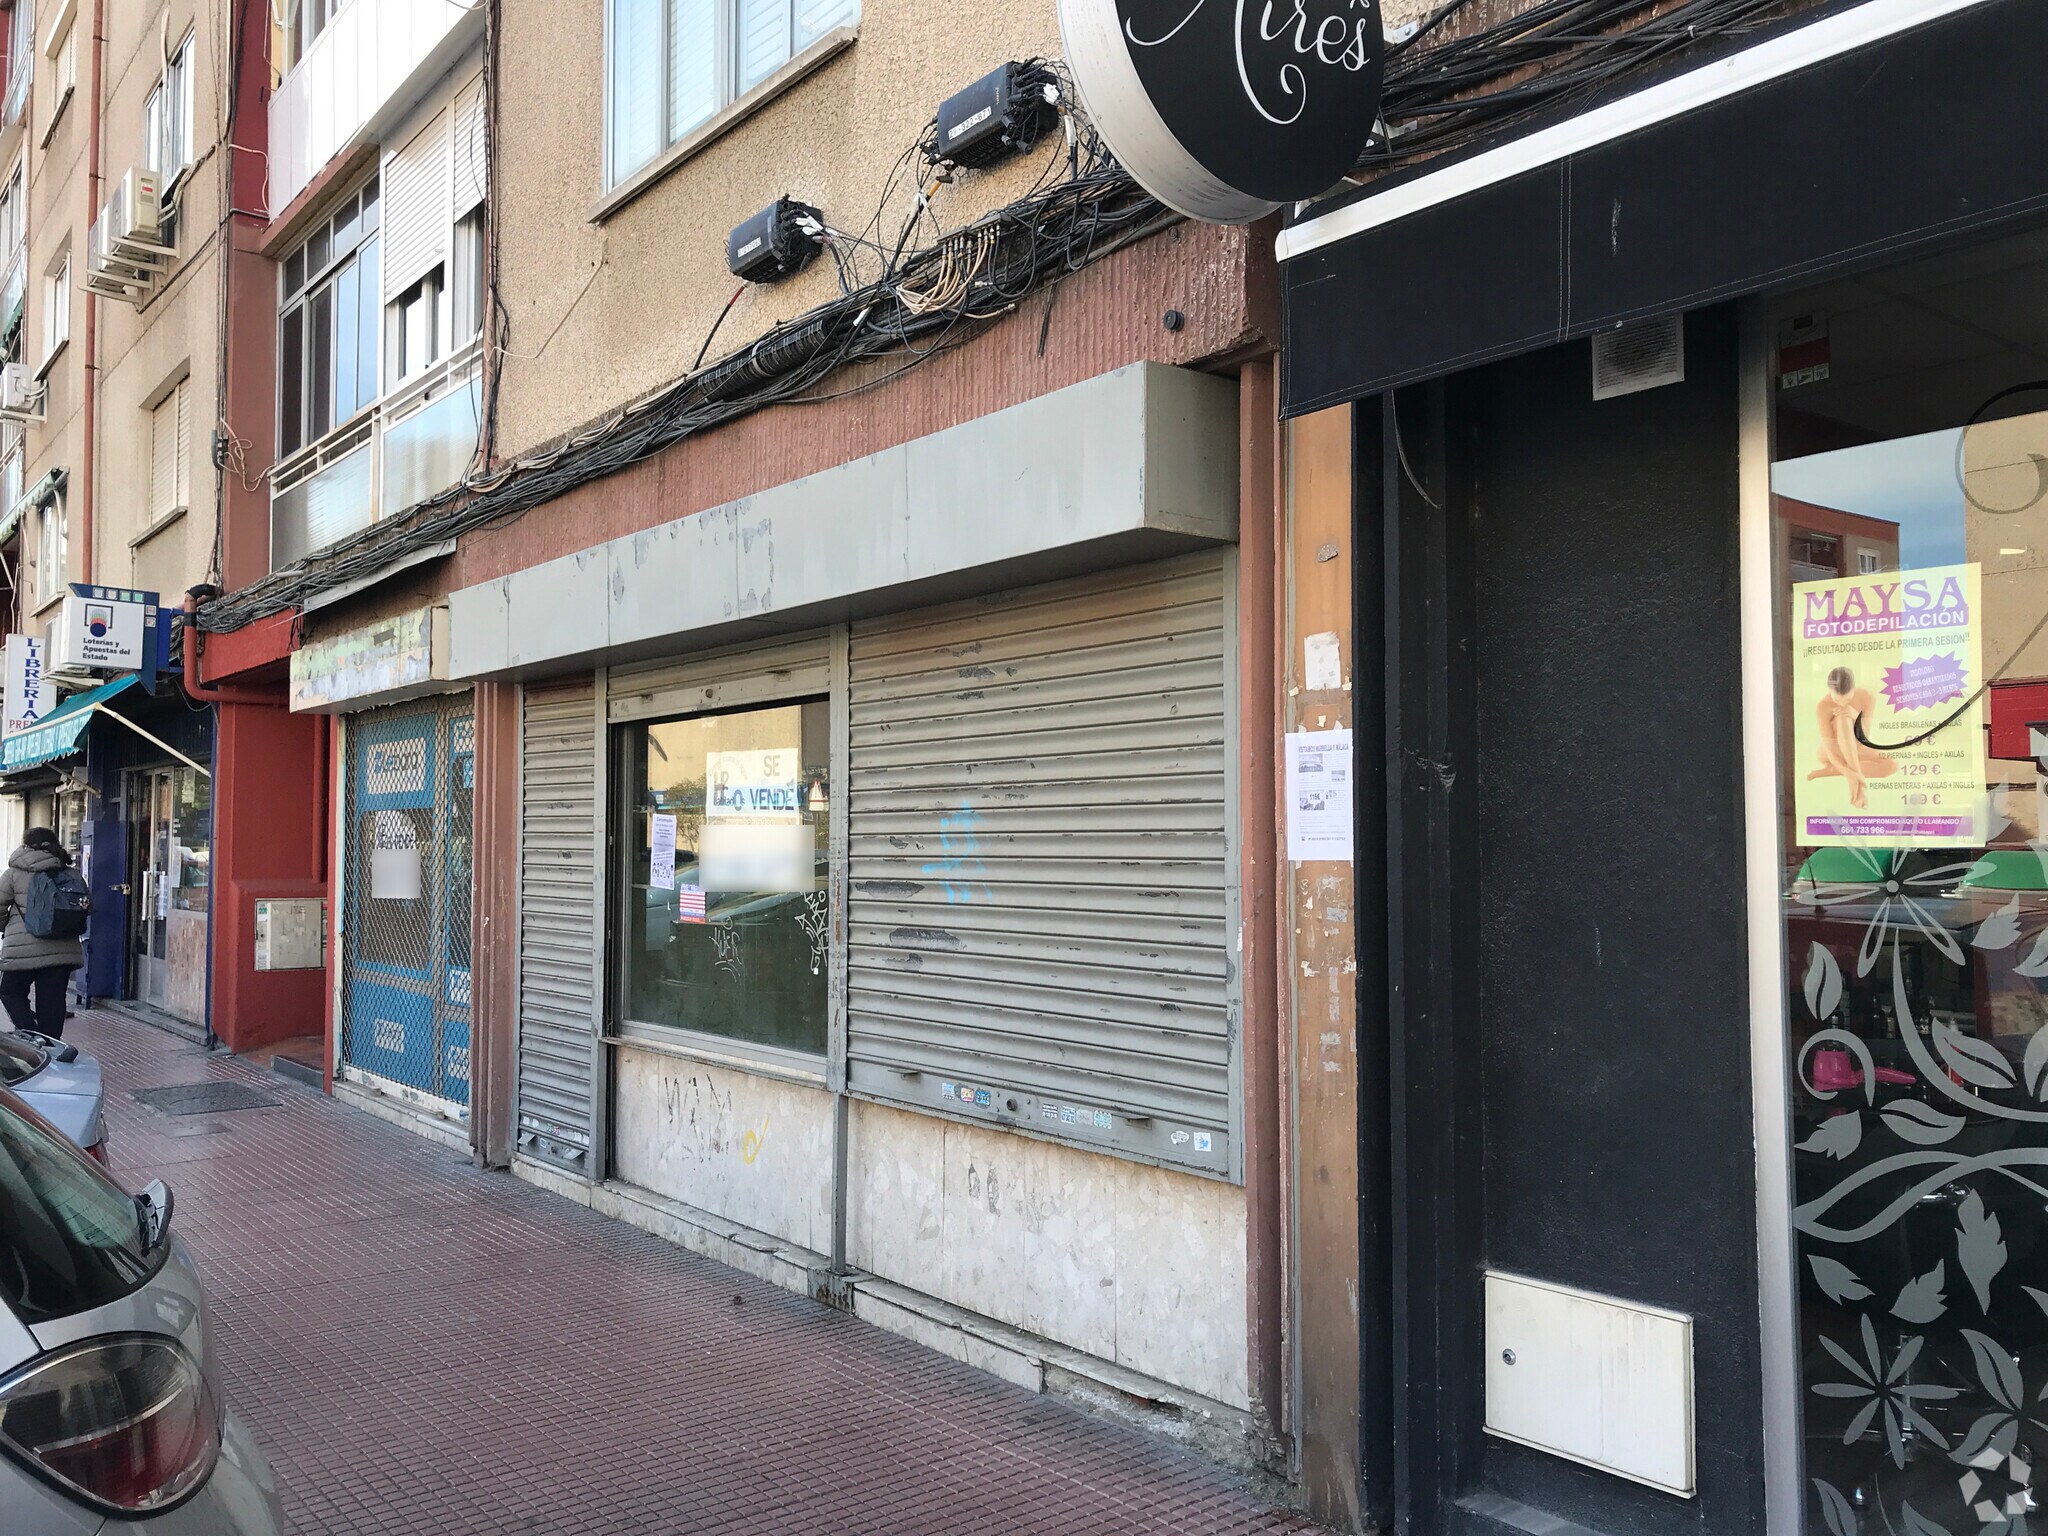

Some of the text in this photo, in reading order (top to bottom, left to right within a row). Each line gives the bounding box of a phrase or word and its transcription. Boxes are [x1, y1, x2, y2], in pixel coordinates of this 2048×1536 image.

[1804, 577, 1967, 621] MAYSA
[1806, 608, 1965, 637] FOTODEPILACIÓN
[83, 637, 113, 647] Loterías
[1857, 640, 1884, 652] DESDE
[1885, 639, 1896, 651] LA
[1897, 635, 1934, 649] PRIMERA
[82, 653, 108, 661] Estado
[83, 646, 131, 656] Apuestas del
[22, 637, 41, 719] LIBRERIA
[1900, 719, 1936, 729] BRASILEÑAS
[1886, 751, 1912, 760] PIERNAS
[1916, 751, 1939, 759] INGLES
[1944, 750, 1965, 758] AXILAS
[763, 754, 781, 777] SE
[1901, 764, 1941, 776] 129 €
[1869, 782, 1894, 790] PIERNAS
[1894, 781, 1921, 790] ENTERAS
[1926, 781, 1948, 789] AXILAS
[1952, 781, 1975, 789] INGLES
[749, 788, 795, 811] VENDE
[1931, 793, 1942, 806] €
[1856, 826, 1869, 834] 733
[1870, 826, 1885, 834] 966
